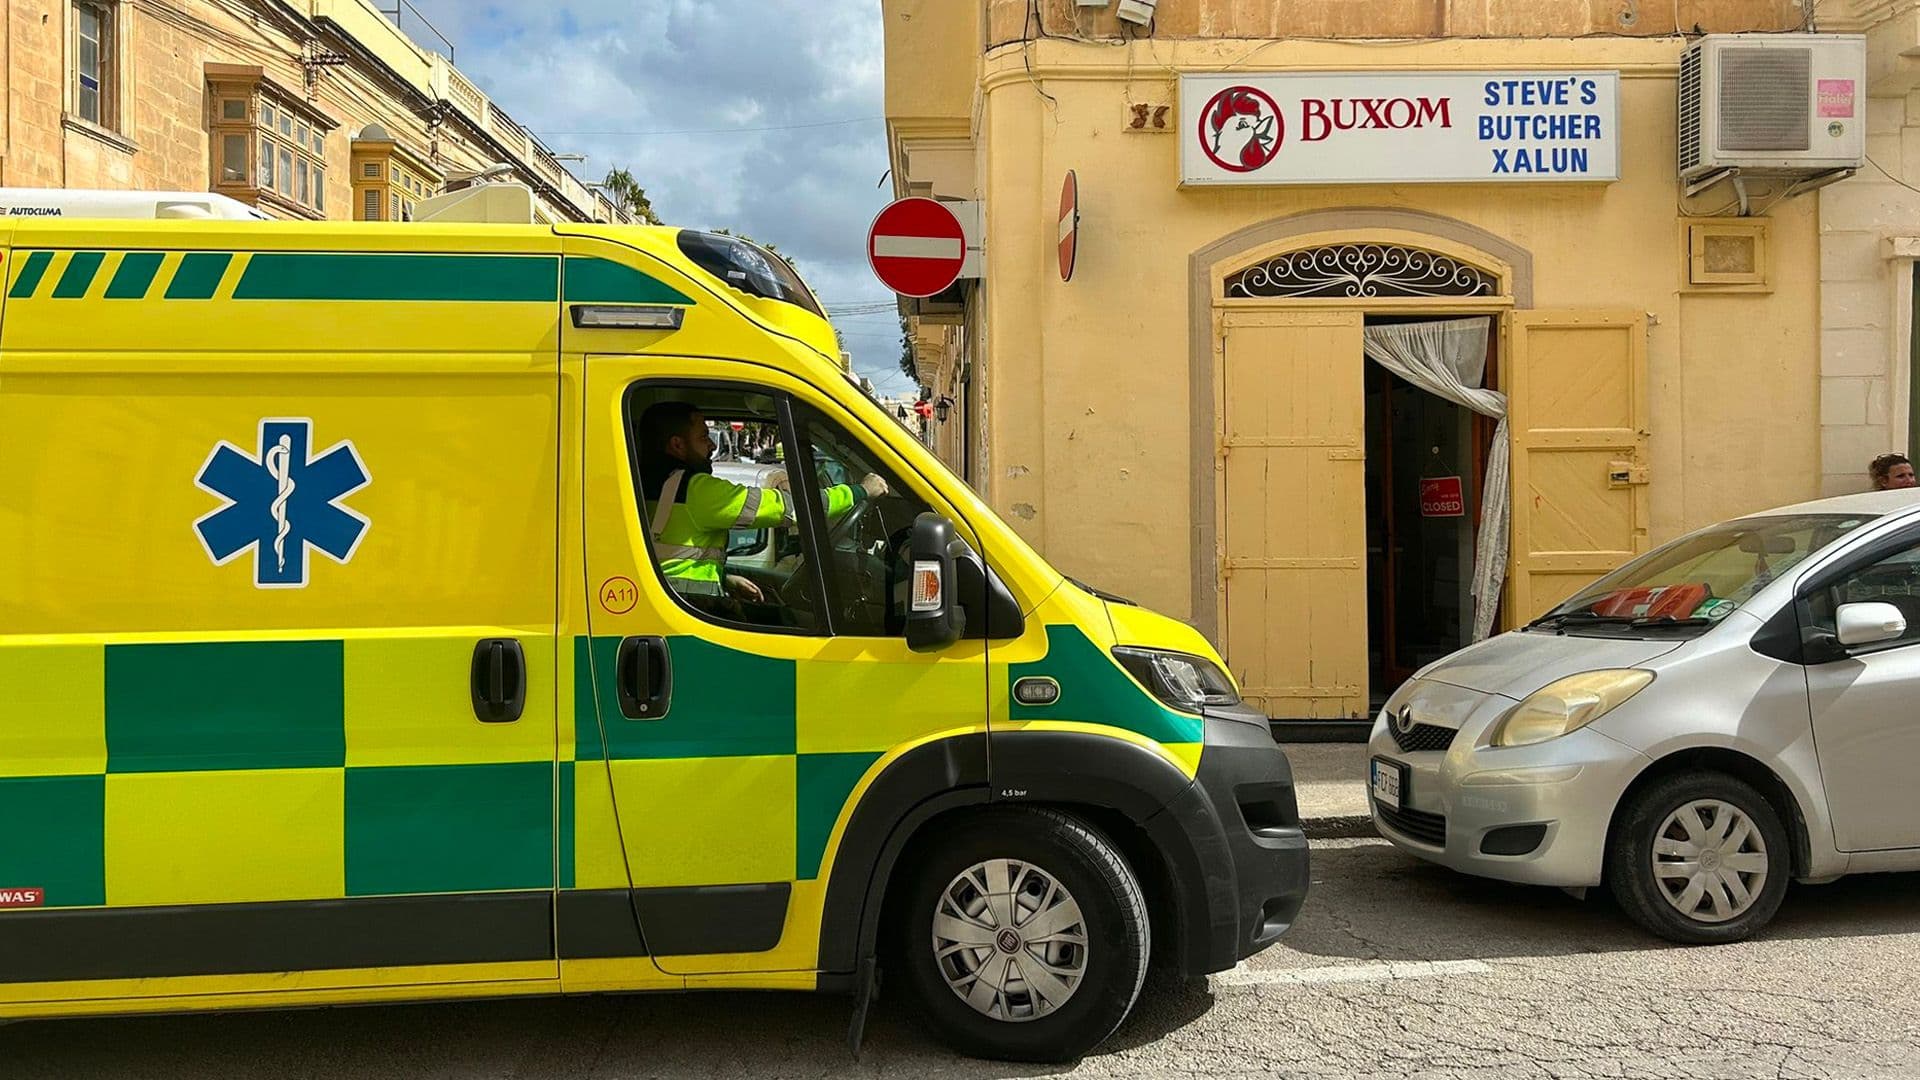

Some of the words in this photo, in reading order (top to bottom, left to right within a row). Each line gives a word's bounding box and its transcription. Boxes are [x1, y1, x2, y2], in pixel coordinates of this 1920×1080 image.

[1484, 77, 1596, 106] STEVE'S
[1300, 98, 1452, 141] BUXOM
[1479, 115, 1601, 140] BUTCHER
[1492, 148, 1588, 173] XALUN
[9, 207, 62, 216] AUTOCLIMA
[1423, 501, 1460, 512] CLOSED
[606, 589, 633, 602] A11
